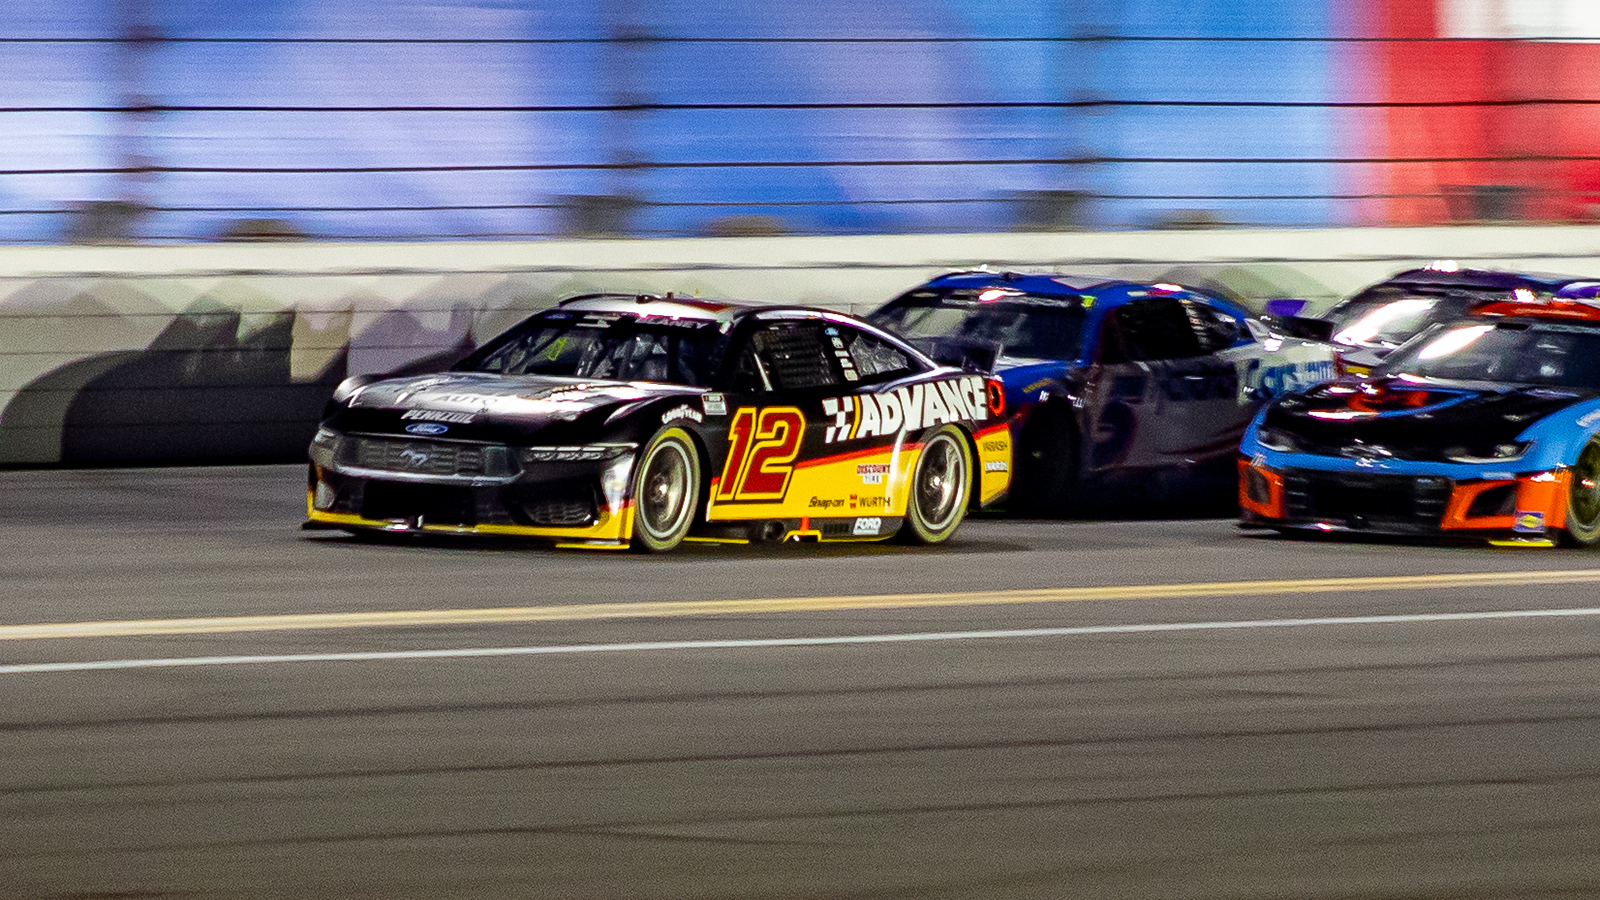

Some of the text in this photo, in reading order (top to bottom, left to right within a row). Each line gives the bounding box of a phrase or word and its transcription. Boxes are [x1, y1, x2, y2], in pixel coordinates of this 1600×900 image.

[856, 376, 988, 438] ADVANCE
[400, 409, 476, 424] PENNZOIL
[715, 406, 806, 503] 12
[857, 464, 890, 474] DISCOUNT
[856, 517, 881, 531] FORD
